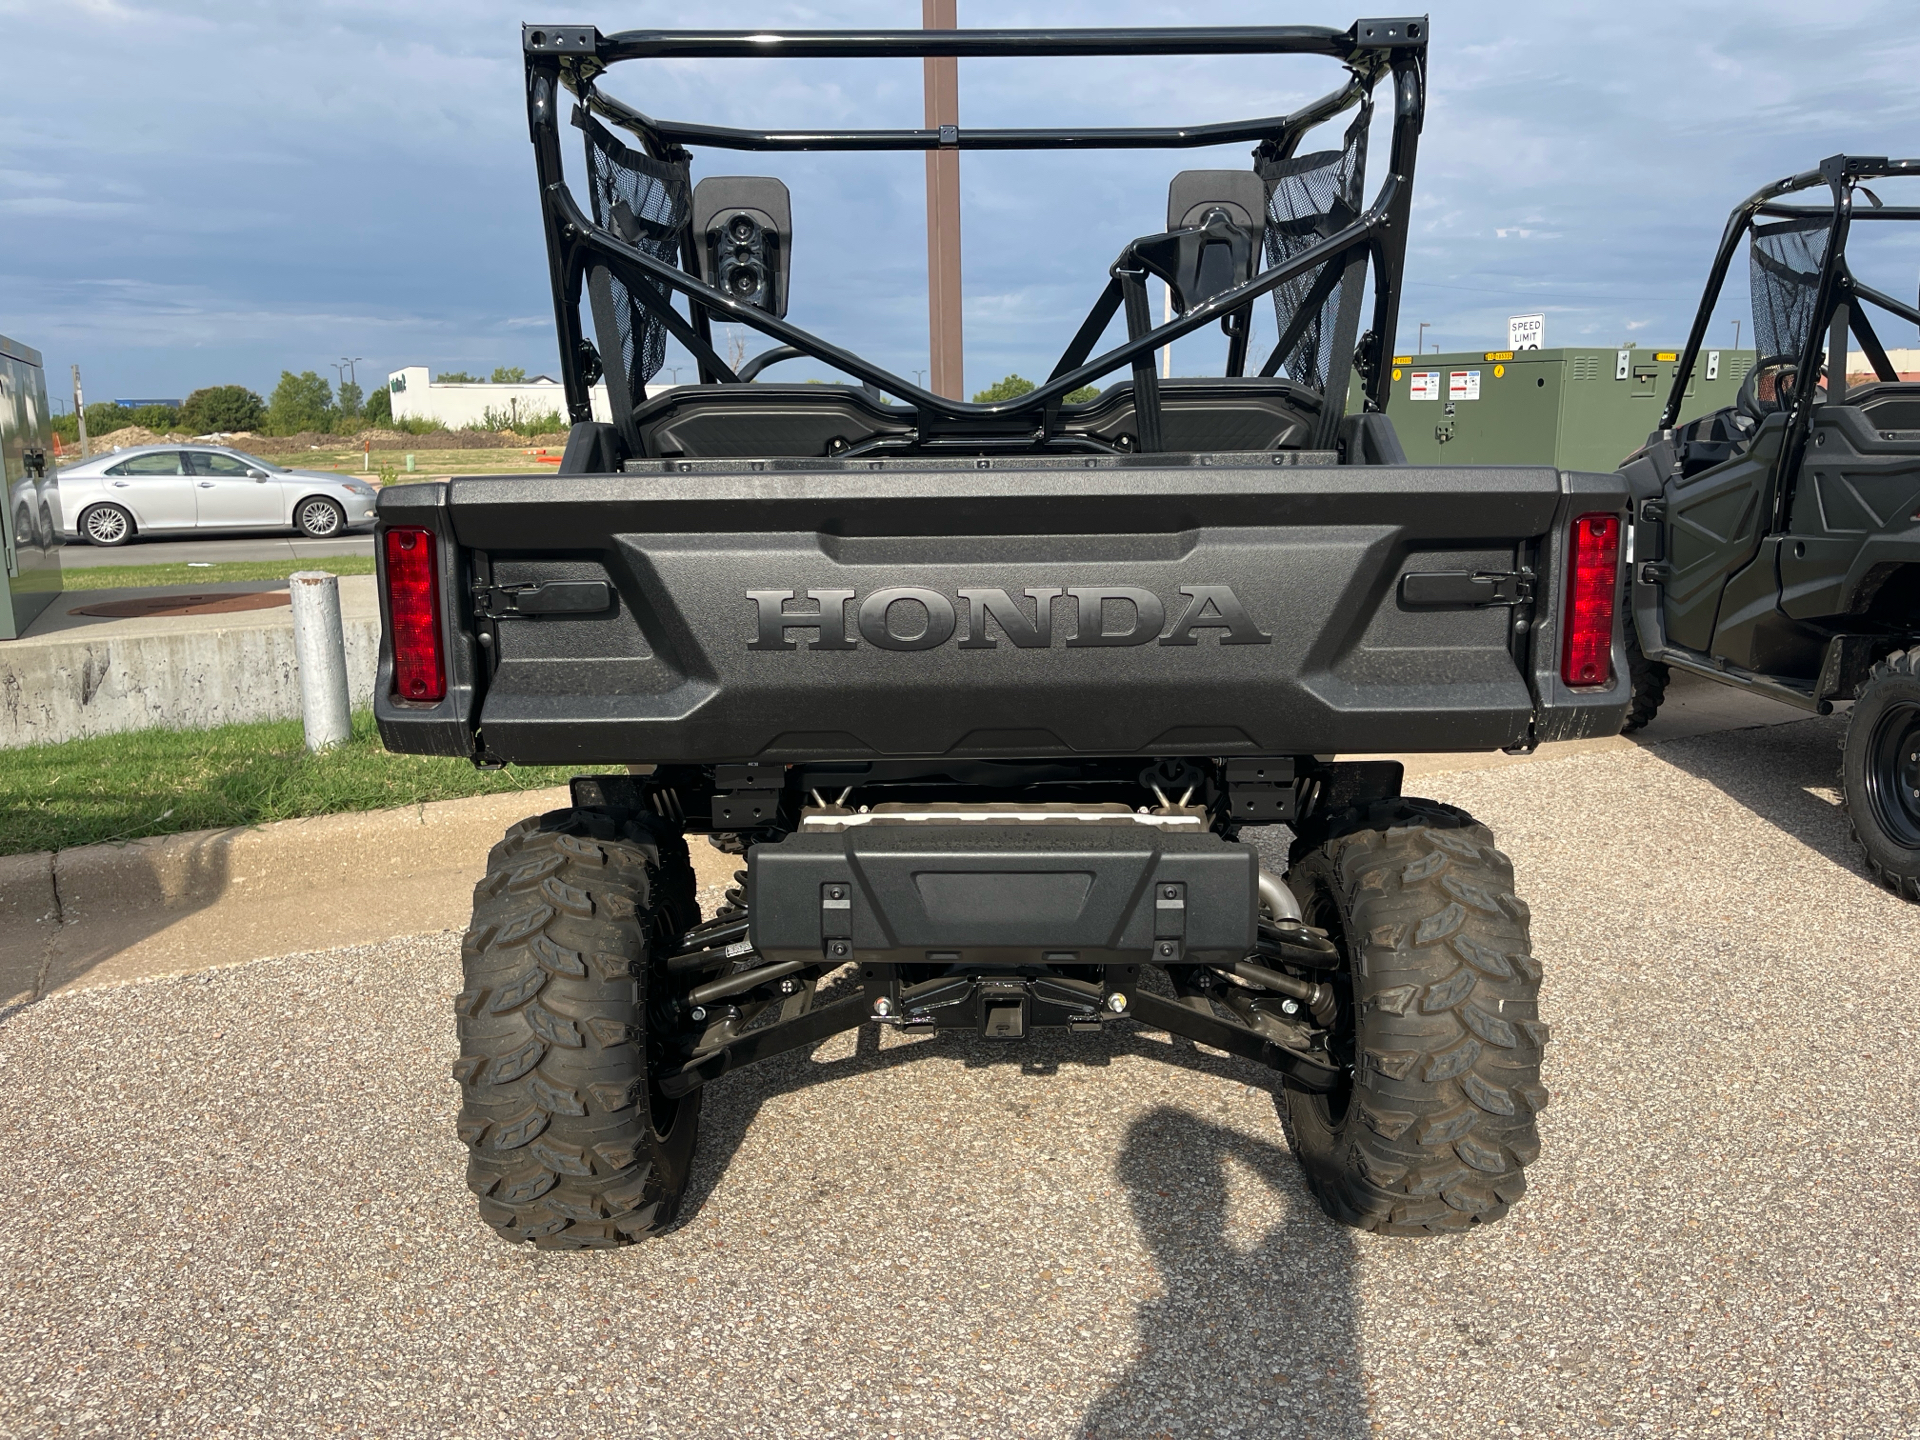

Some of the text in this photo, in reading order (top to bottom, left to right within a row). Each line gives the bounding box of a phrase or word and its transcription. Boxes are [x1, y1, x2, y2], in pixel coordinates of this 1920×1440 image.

[1512, 321, 1540, 331] SPEED
[1515, 332, 1536, 342] LIMIT
[746, 585, 1272, 651] HONDA
